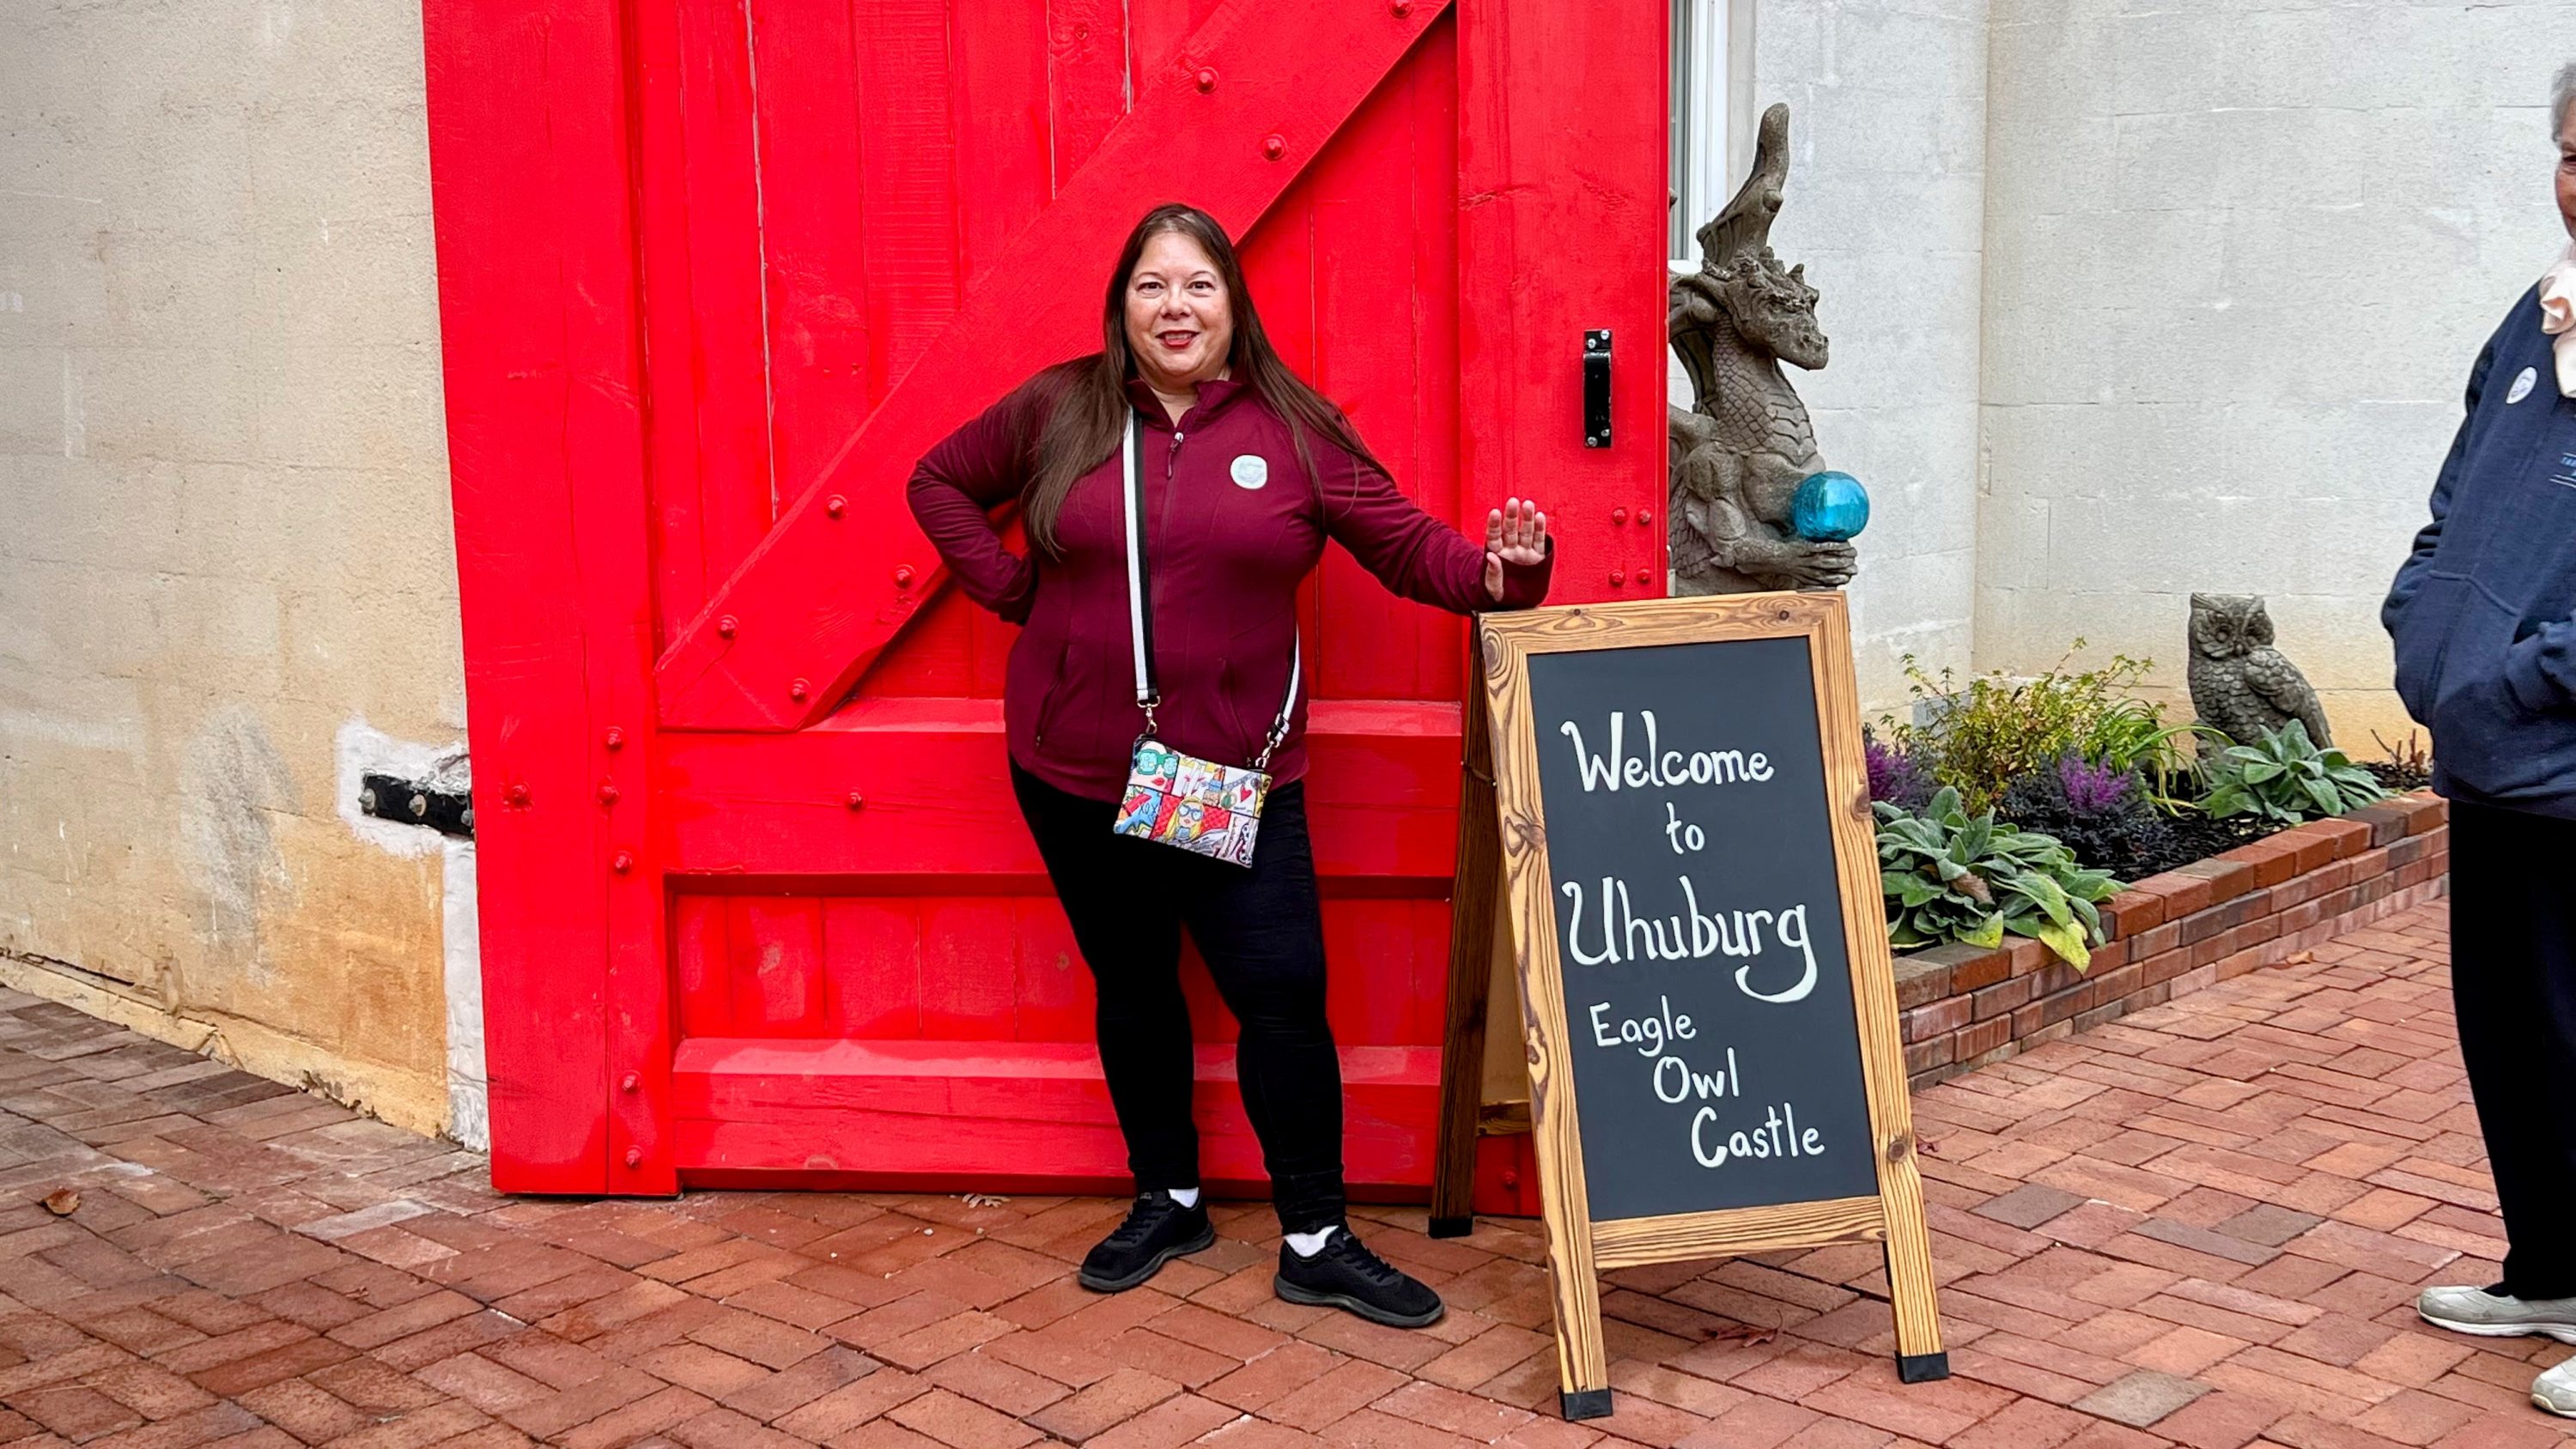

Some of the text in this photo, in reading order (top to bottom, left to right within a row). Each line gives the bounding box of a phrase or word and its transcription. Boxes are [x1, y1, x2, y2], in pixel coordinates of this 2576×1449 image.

[1560, 710, 1775, 792] Welcome
[1665, 802, 1705, 855] to
[1561, 875, 1818, 1003] Uhuburg
[1589, 995, 1697, 1058] Eagle
[1653, 1046, 1740, 1103] Owl
[1691, 1102, 1826, 1168] Castle
